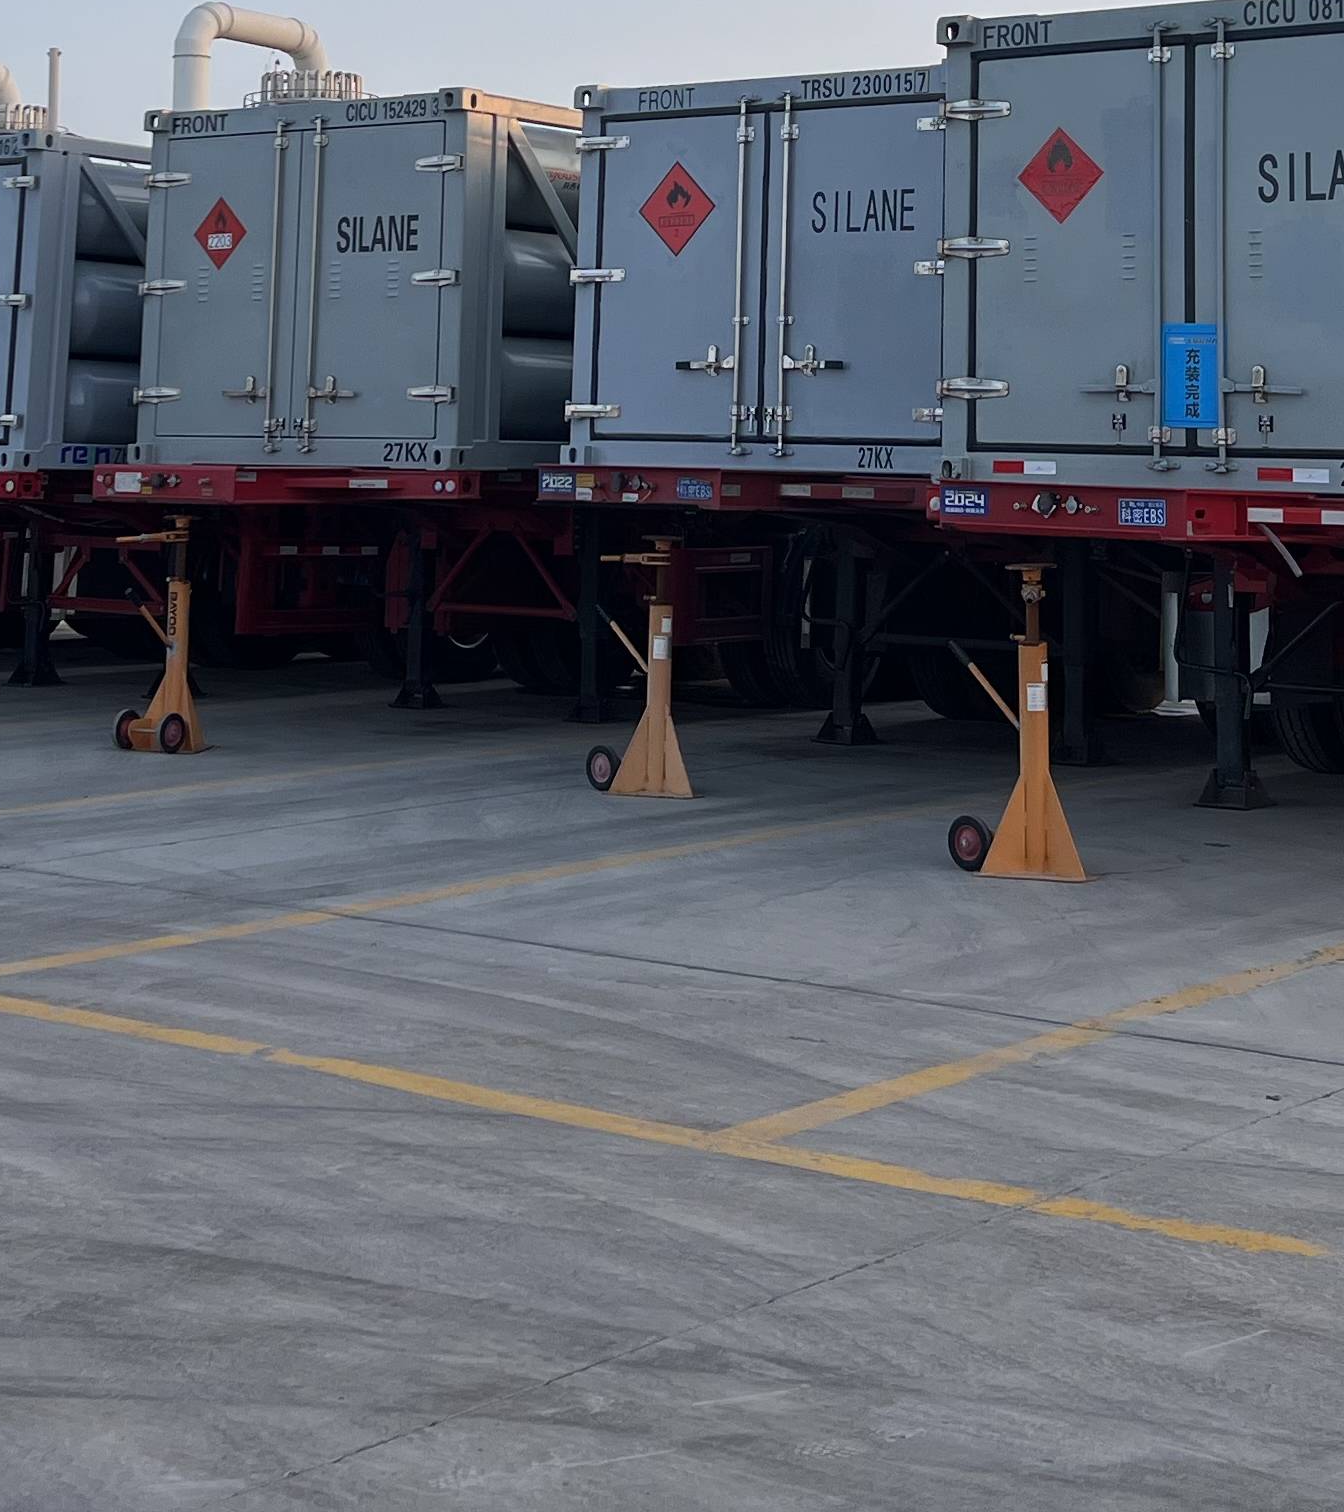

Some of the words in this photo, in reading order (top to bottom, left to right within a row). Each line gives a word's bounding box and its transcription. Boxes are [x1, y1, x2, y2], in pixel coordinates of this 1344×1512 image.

[982, 19, 1053, 50] FRONT
[638, 87, 695, 112] FRONT
[801, 77, 845, 100] TRSU
[172, 113, 228, 136] FRONT
[345, 103, 378, 122] CICU
[811, 188, 915, 233] SILANE
[335, 214, 419, 254] SILANE
[1184, 347, 1201, 419] 充装完成
[382, 442, 428, 464] 27KX
[857, 446, 894, 470] 27KX
[944, 492, 986, 507] 2024
